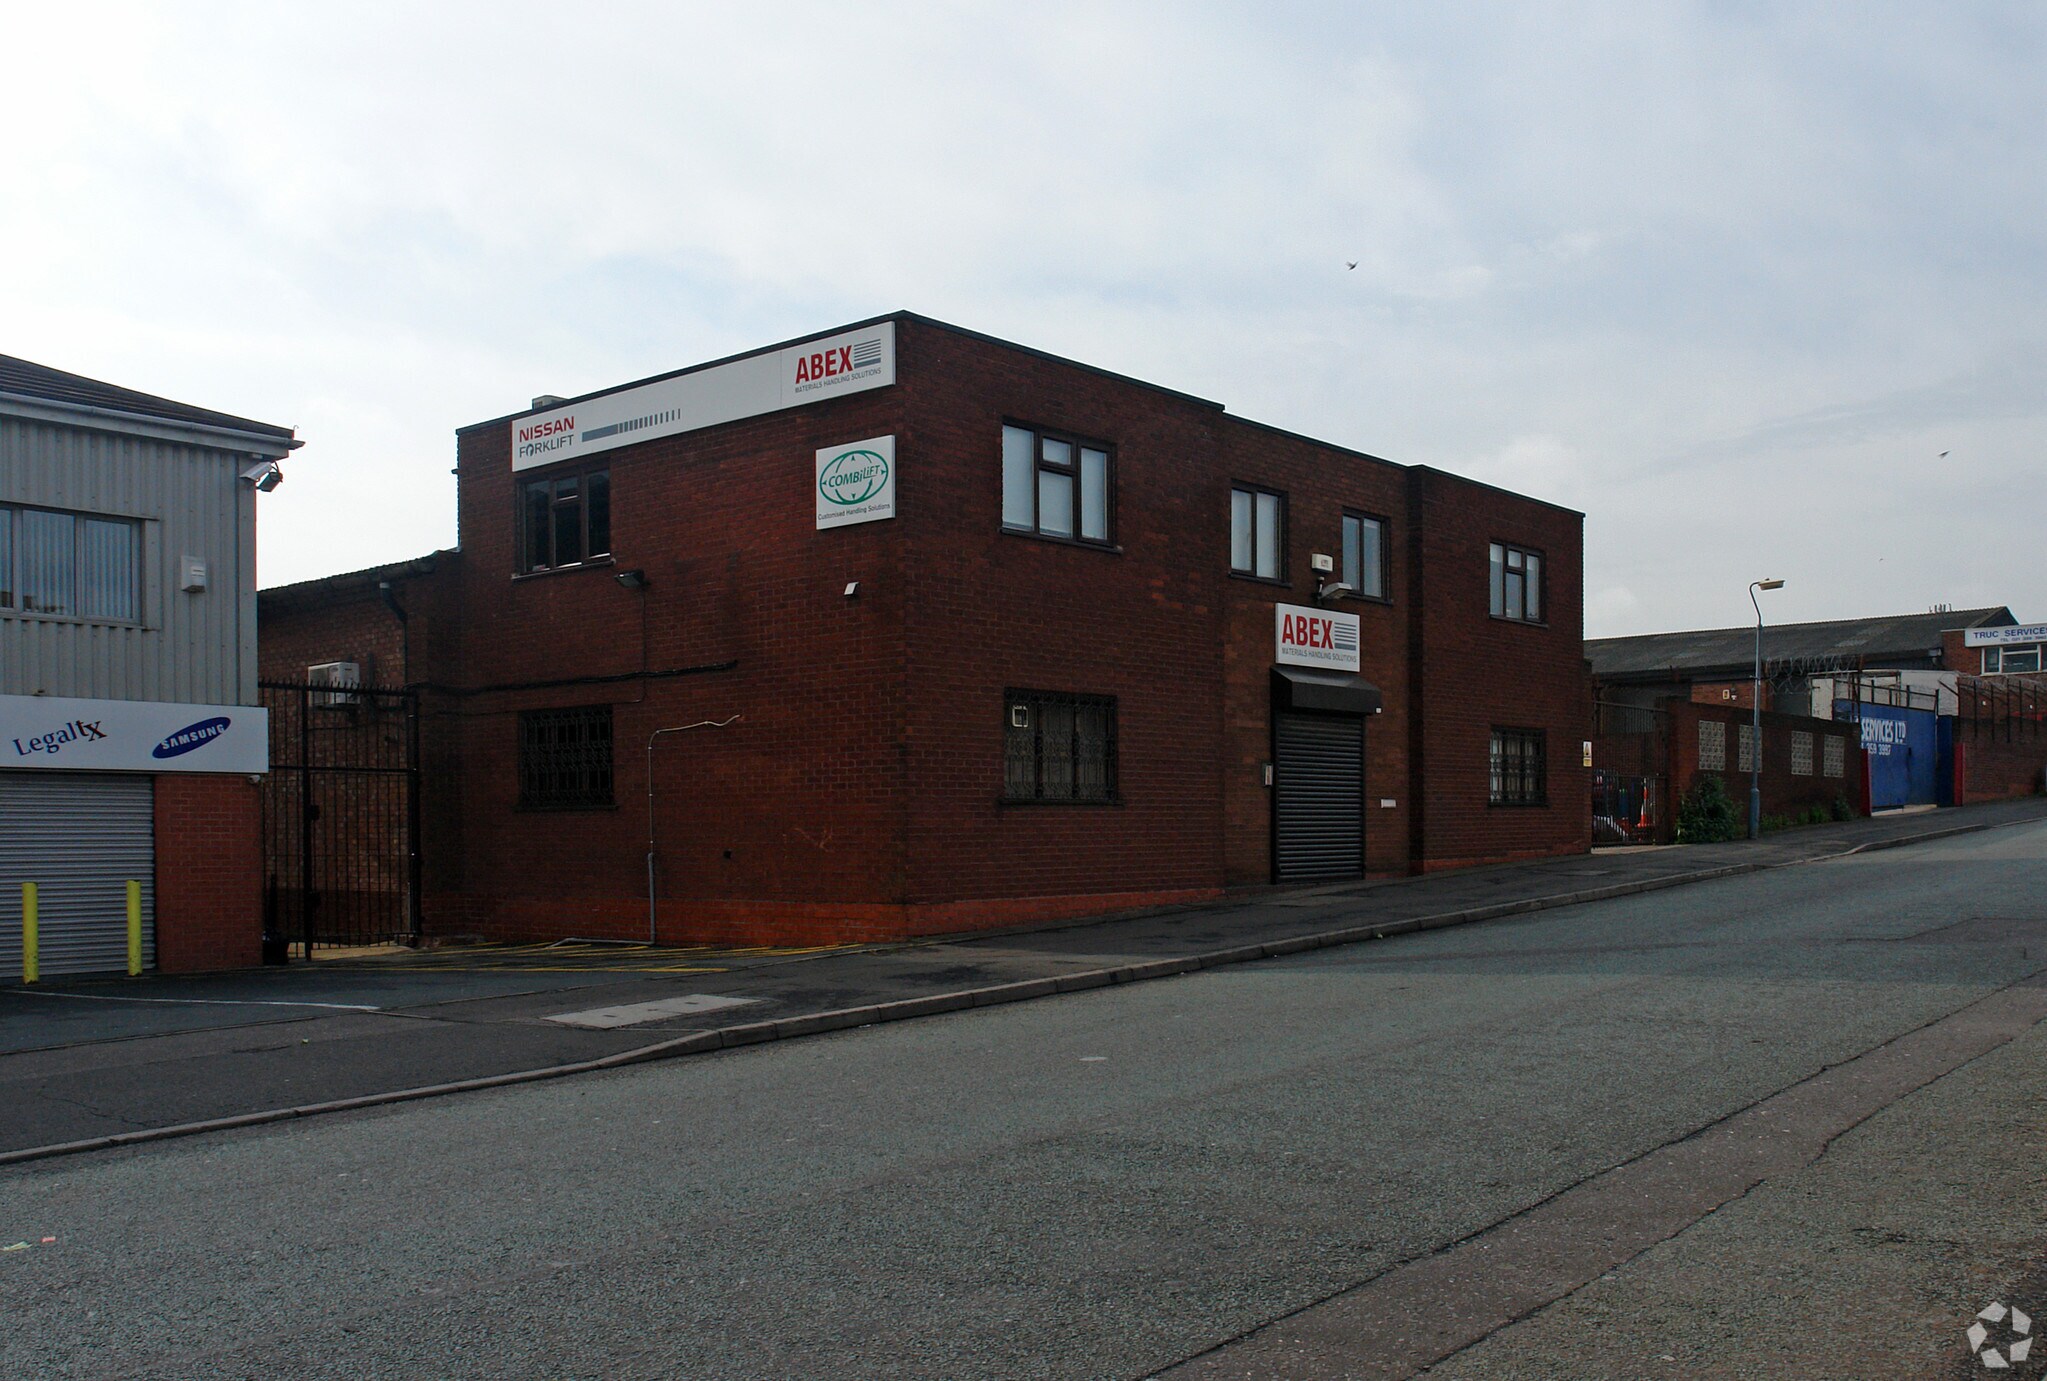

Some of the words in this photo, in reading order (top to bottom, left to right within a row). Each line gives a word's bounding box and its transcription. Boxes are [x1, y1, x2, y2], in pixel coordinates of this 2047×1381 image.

[795, 344, 854, 385] ABEX
[795, 381, 823, 394] MATERIALS
[823, 375, 850, 388] HANDLING
[851, 367, 882, 381] SOLUTIONS
[519, 415, 575, 443] NISSAN
[519, 433, 575, 458] FORKLIFT
[845, 506, 867, 517] Handling
[867, 502, 891, 513] Solutions
[1281, 613, 1334, 650] ABEX
[1973, 630, 1999, 639] TRUC
[1281, 647, 1308, 658] MATERIALS
[1308, 650, 1332, 661] HANDLING
[1332, 652, 1357, 663] SOLUTIONS
[161, 723, 226, 751] SAMSUNG
[1861, 718, 1894, 743] SERVICES
[1894, 721, 1907, 744] LTD
